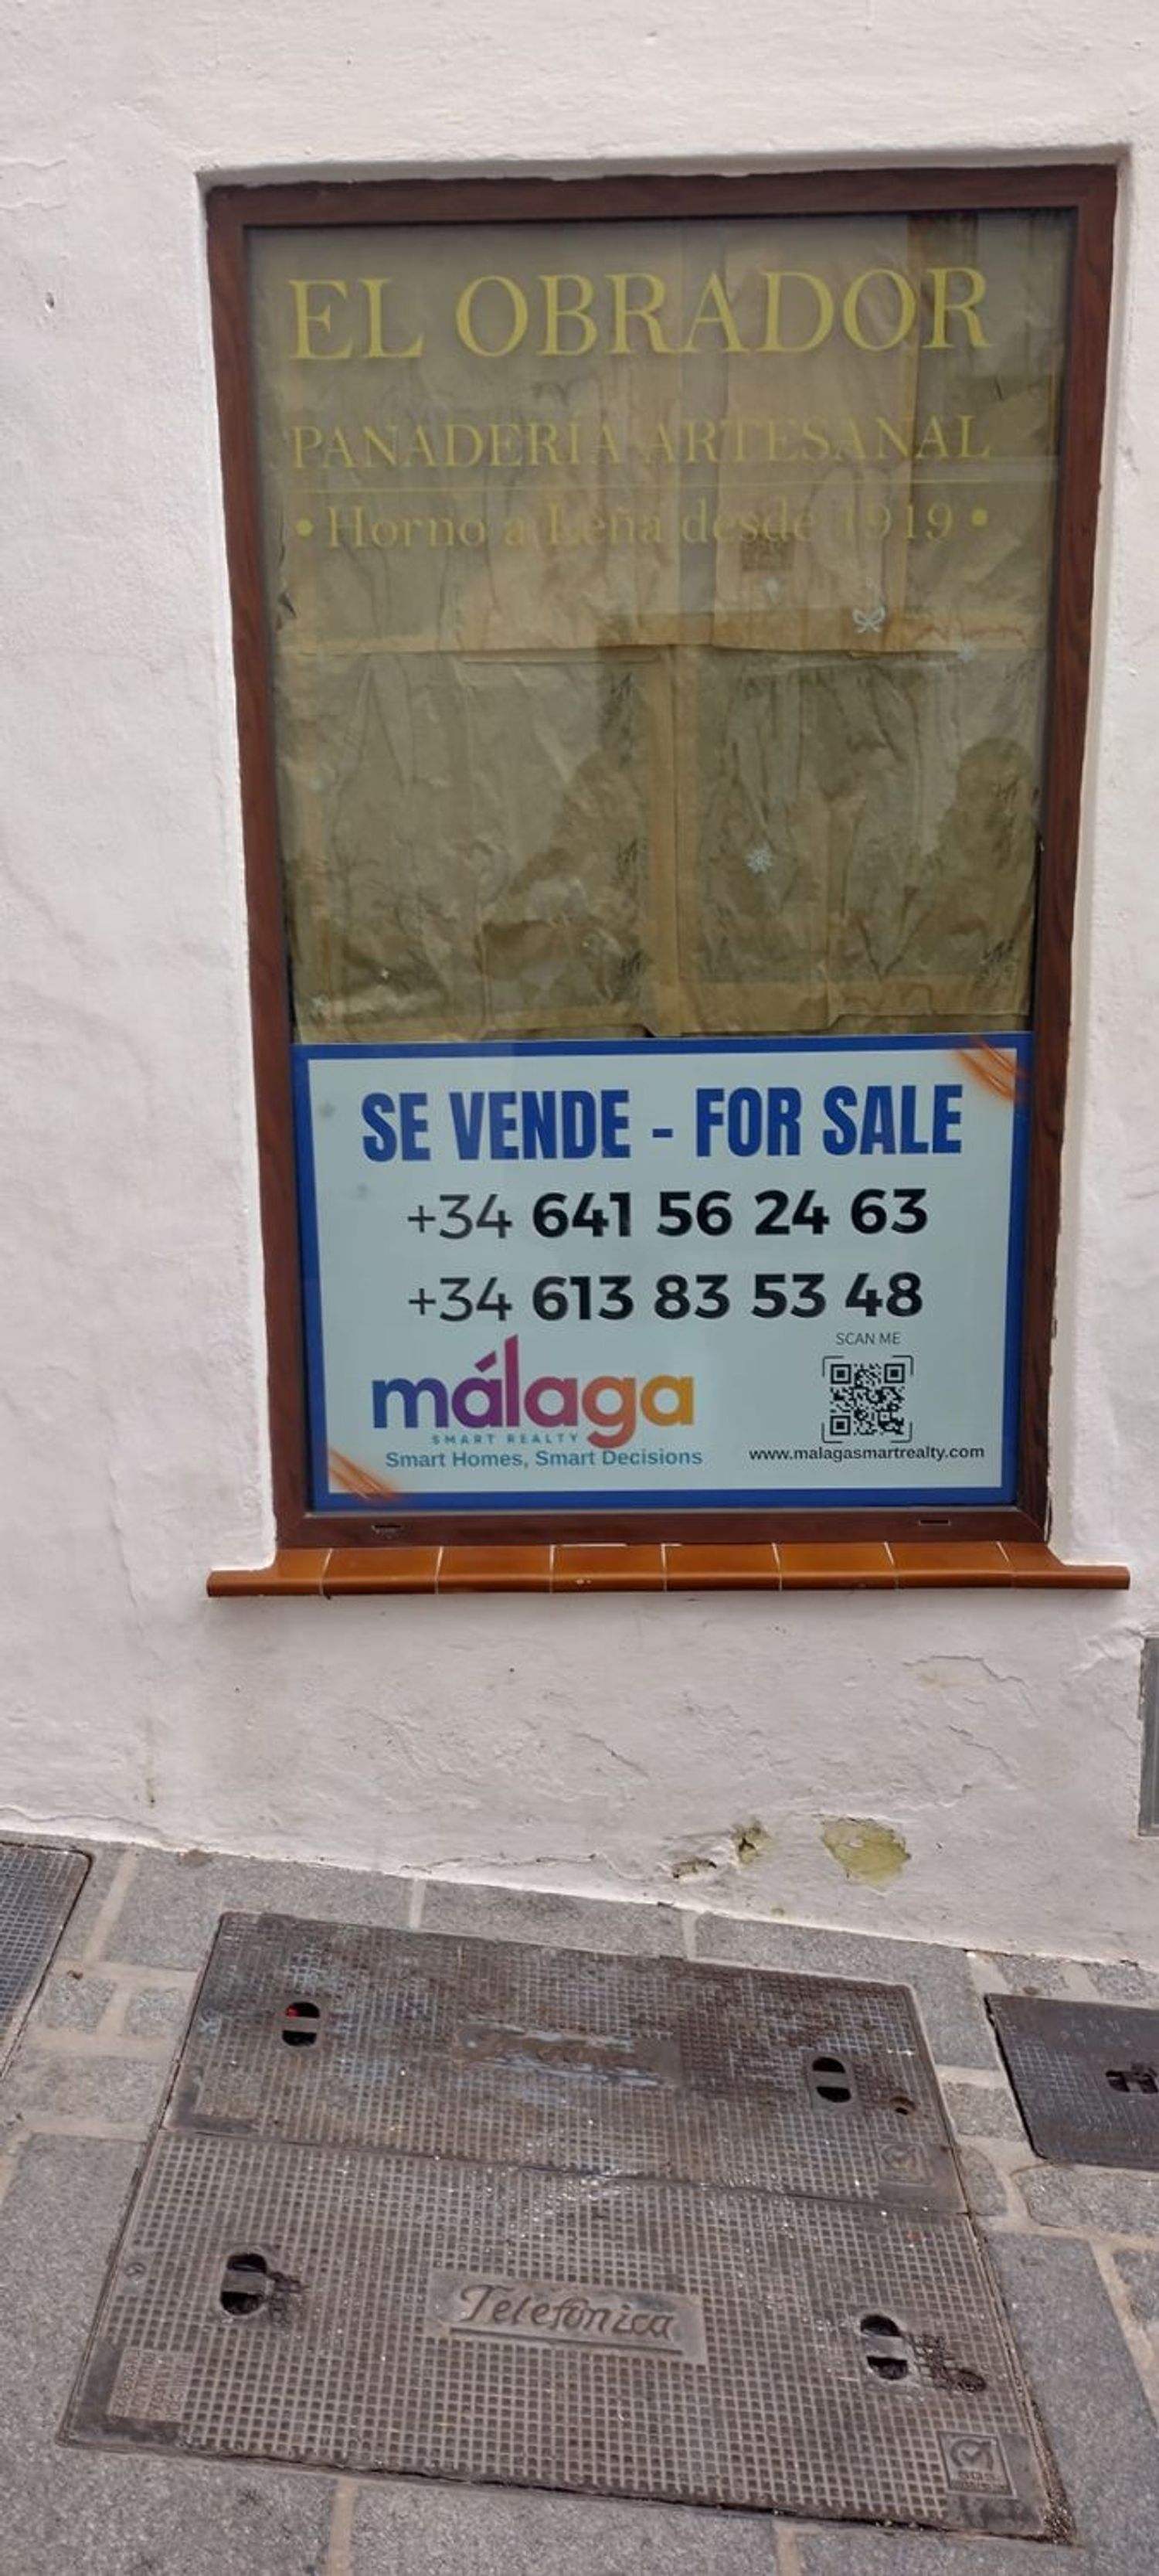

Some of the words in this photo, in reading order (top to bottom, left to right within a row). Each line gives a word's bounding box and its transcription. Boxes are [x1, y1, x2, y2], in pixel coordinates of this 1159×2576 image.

[288, 277, 424, 361] EL
[455, 267, 993, 358] OBRADOR
[643, 414, 991, 464] ARTESANAL
[327, 506, 487, 549] Horno
[505, 518, 527, 546] a
[682, 497, 813, 544] desde
[840, 501, 954, 541] 1919
[361, 1092, 431, 1162] SE
[449, 1089, 630, 1160] VENDE
[696, 1087, 801, 1157] FOR
[822, 1084, 963, 1155] SALE
[407, 1193, 512, 1239] +34
[533, 1191, 631, 1238] 641
[657, 1189, 732, 1237] 56
[754, 1189, 830, 1236] 24
[851, 1188, 928, 1234] 63
[408, 1276, 512, 1322] +34
[532, 1274, 634, 1322] 613
[654, 1273, 730, 1319] 83
[751, 1272, 826, 1319] 53
[845, 1271, 923, 1317] 48
[835, 1332, 875, 1346] SCAN
[879, 1331, 901, 1345] ME
[372, 1334, 694, 1449] málaga
[386, 1451, 445, 1468] Smart
[453, 1450, 529, 1468] Homes,
[535, 1449, 595, 1467] Smart
[603, 1448, 702, 1465] Decisions
[431, 1434, 496, 1445] SMART
[507, 1432, 579, 1445] REALTY
[749, 1445, 985, 1462] www.malagasmartrealty.com
